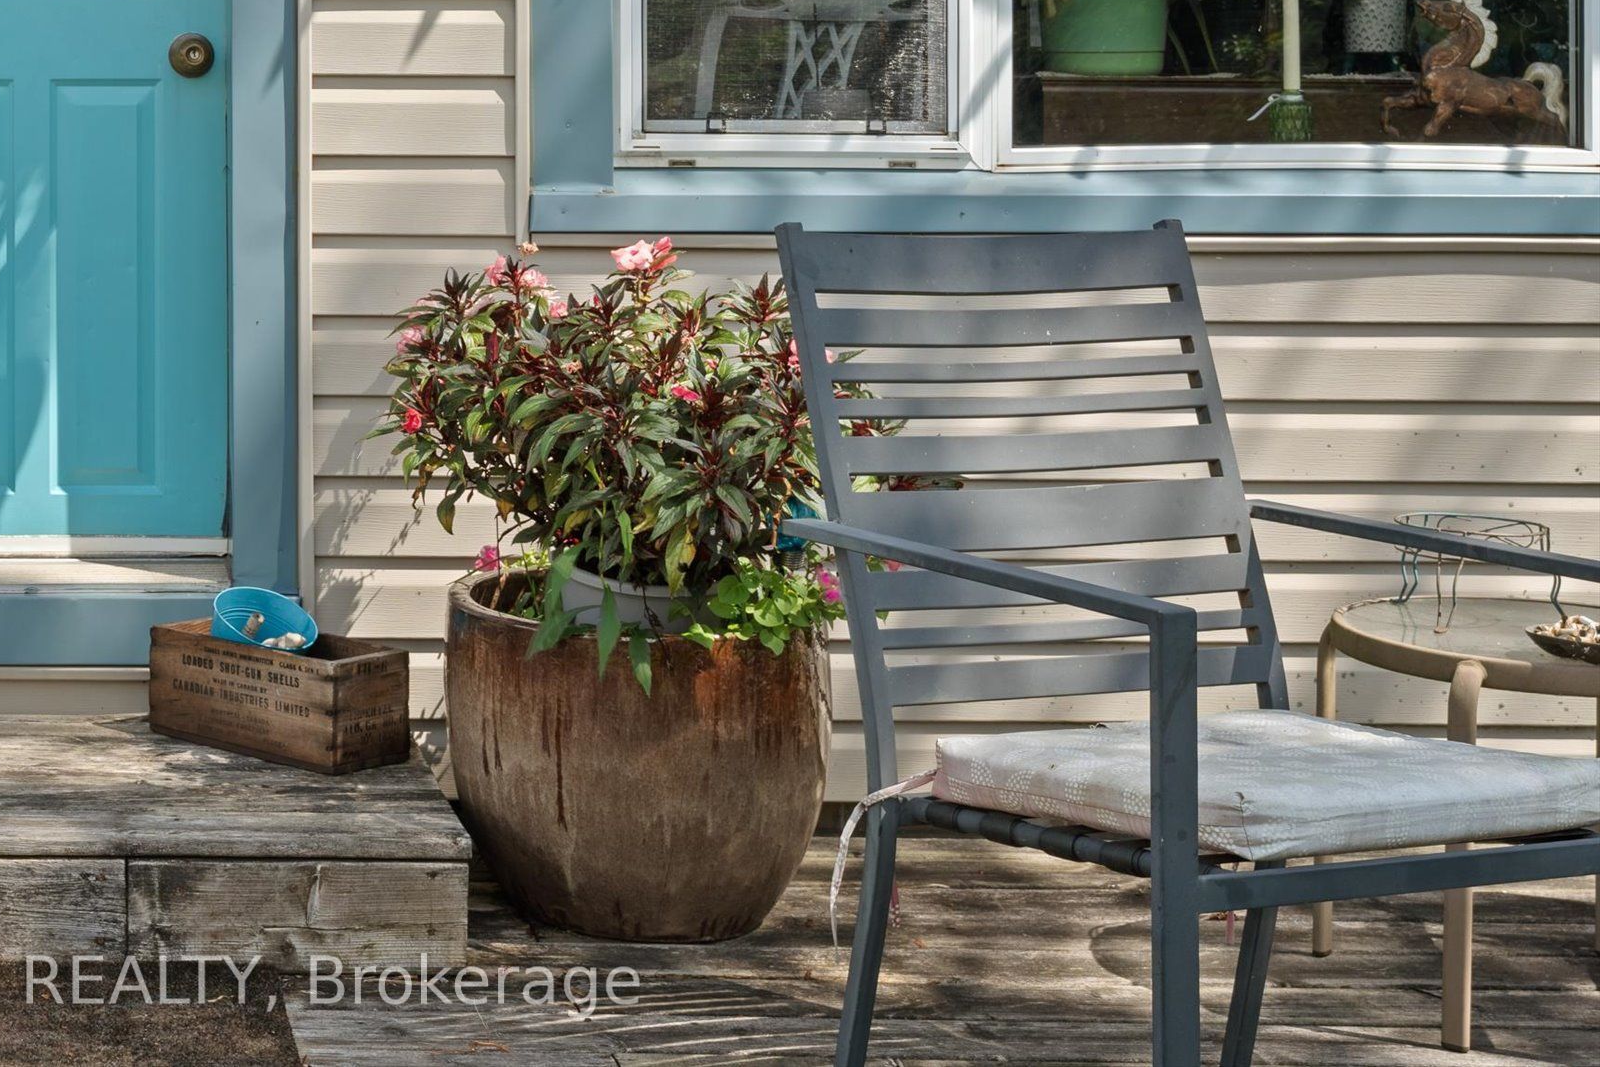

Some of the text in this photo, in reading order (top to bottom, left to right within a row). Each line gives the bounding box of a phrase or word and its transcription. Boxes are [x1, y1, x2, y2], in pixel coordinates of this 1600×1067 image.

[182, 654, 300, 689] LOADED SHOT-GUN SHELLS
[172, 678, 311, 718] CANADIAN INDUSTRIES LIMITED
